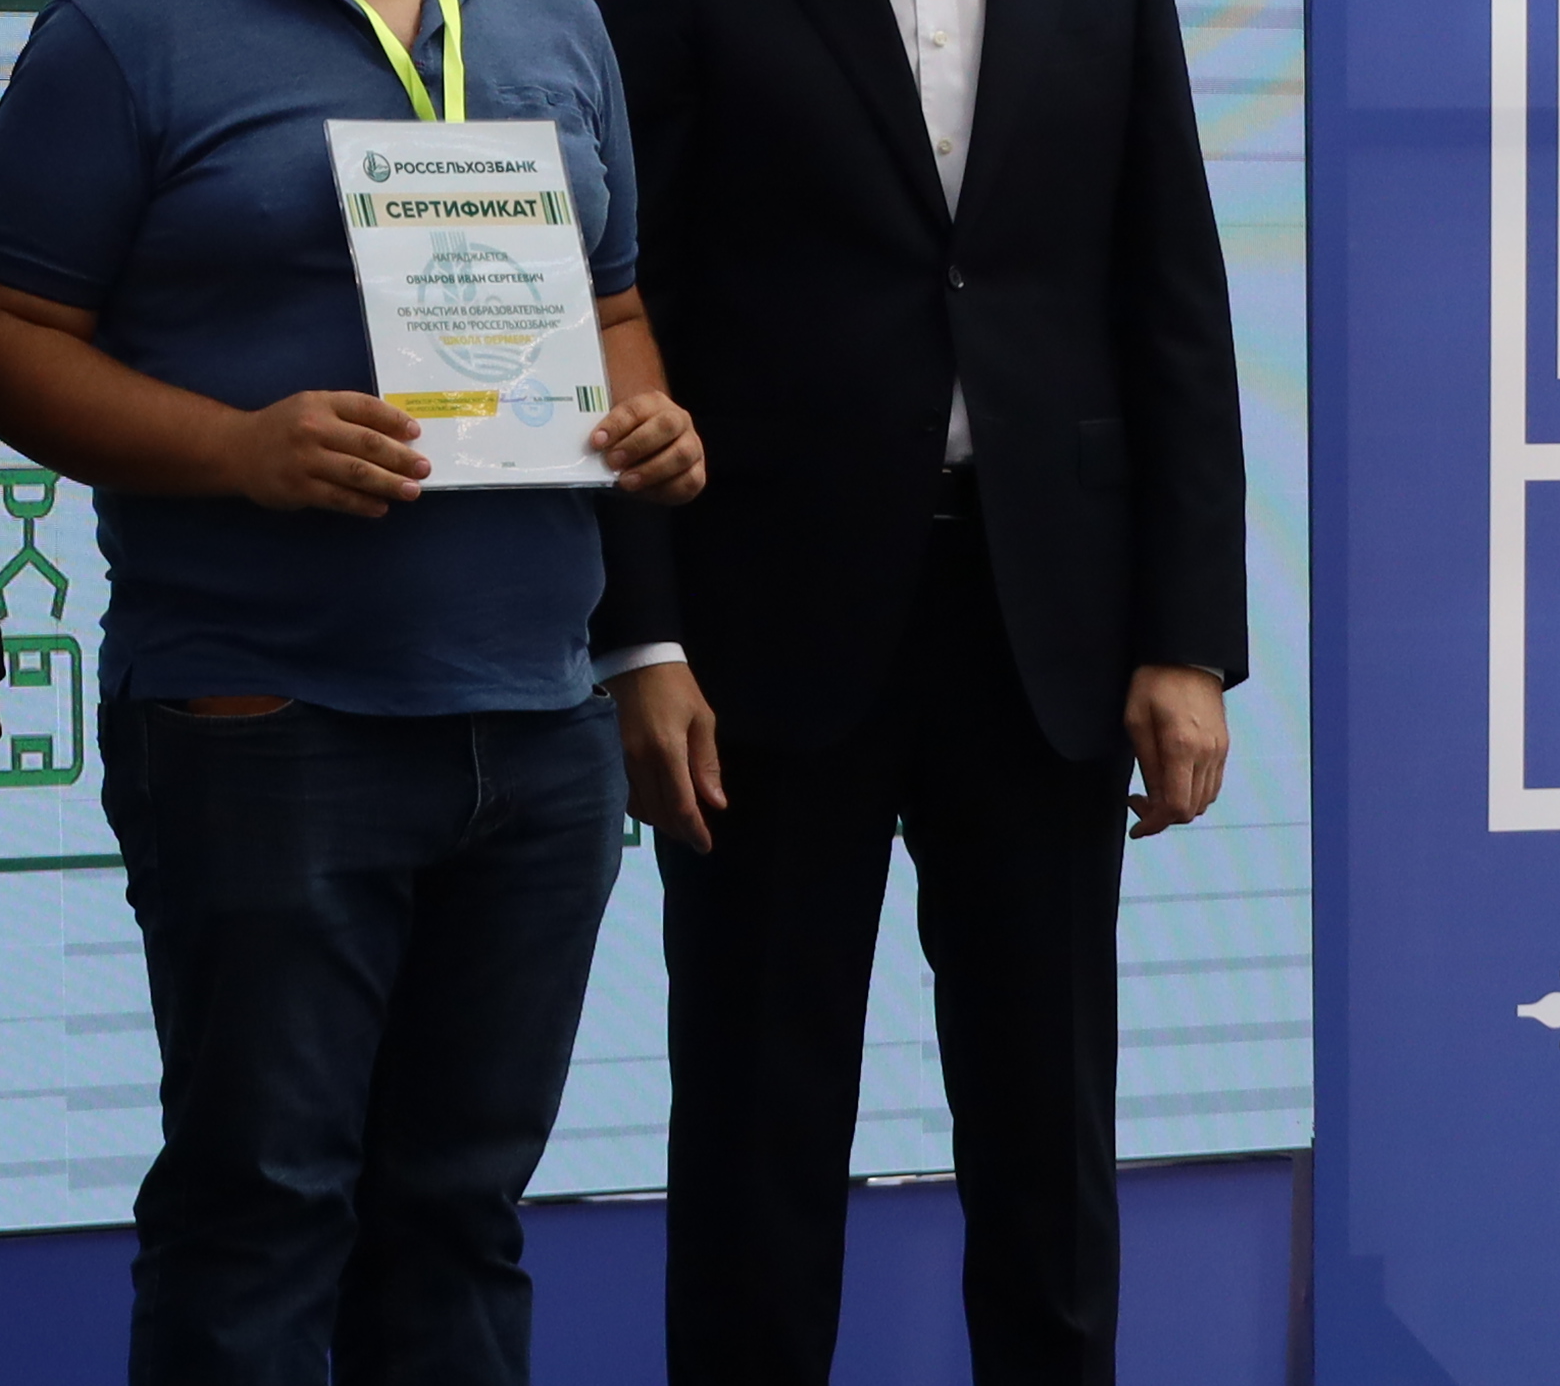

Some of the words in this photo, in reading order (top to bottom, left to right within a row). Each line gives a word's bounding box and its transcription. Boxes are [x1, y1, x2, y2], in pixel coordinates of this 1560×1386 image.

[394, 161, 538, 175] РОССЕЛЬХОЗБАНК
[386, 199, 537, 219] СЕРТИФИКАТ
[406, 274, 455, 284] ОВЧАРОВ
[457, 274, 486, 284] ИВАН
[487, 273, 544, 283] СЕРГЕЕВИЧ
[397, 307, 412, 317] ОБ
[413, 306, 459, 317] УЧАСТИИ
[468, 304, 565, 316] ОБРАЗОВАТЕЛЬНОМ
[407, 321, 450, 331] ПРОЕКТЕ
[452, 321, 466, 330] АО
